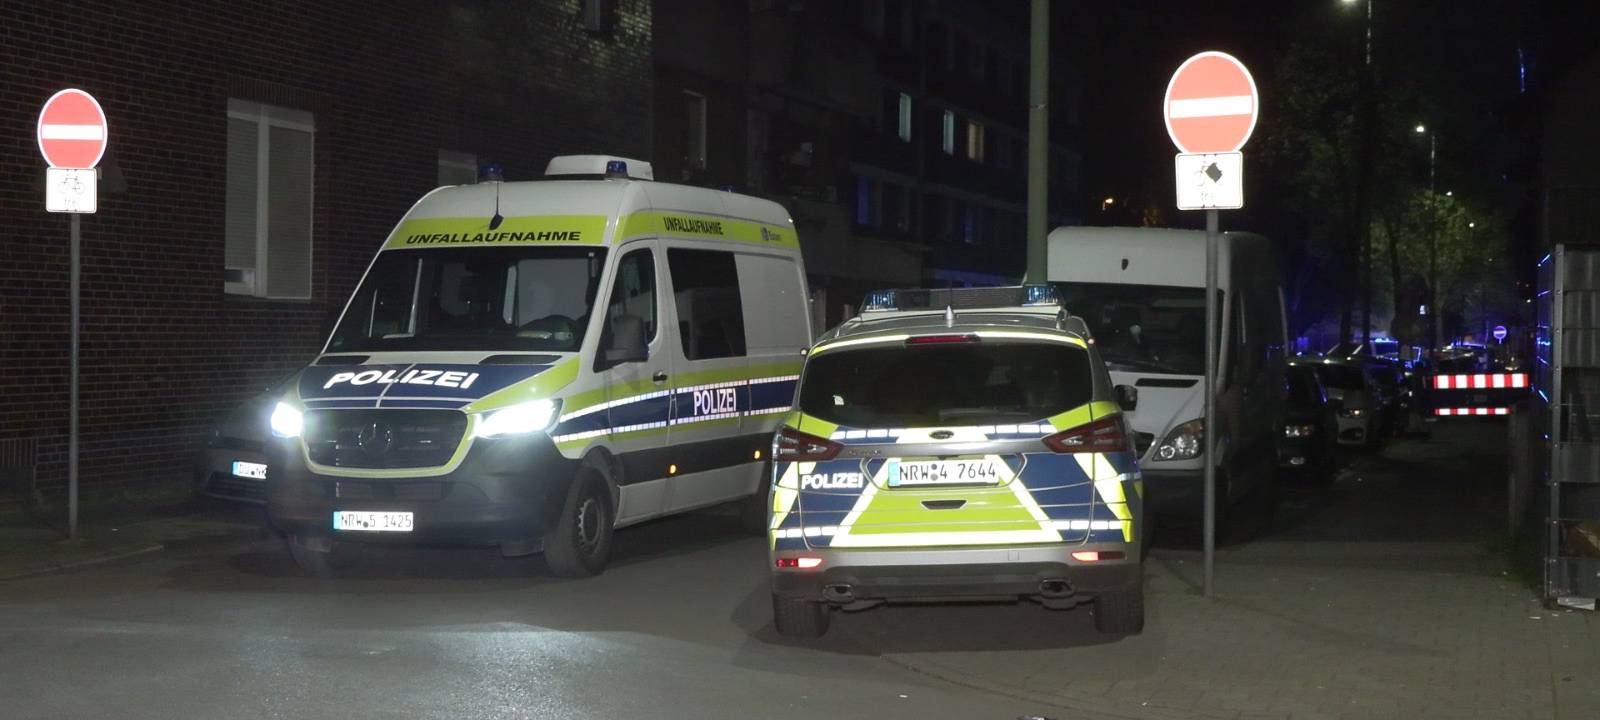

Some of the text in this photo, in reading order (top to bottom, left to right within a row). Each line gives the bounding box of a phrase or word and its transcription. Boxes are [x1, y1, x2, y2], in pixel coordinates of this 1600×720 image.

[662, 216, 724, 236] UNFALLAUFNAHME
[406, 231, 581, 245] UNFALLAUFNAHME
[323, 369, 480, 390] POLIZEI
[693, 387, 737, 416] POLIZEI
[801, 472, 864, 490] POLIZEI
[900, 465, 929, 482] NRW
[957, 462, 997, 479] 7644
[383, 513, 412, 528] 1425
